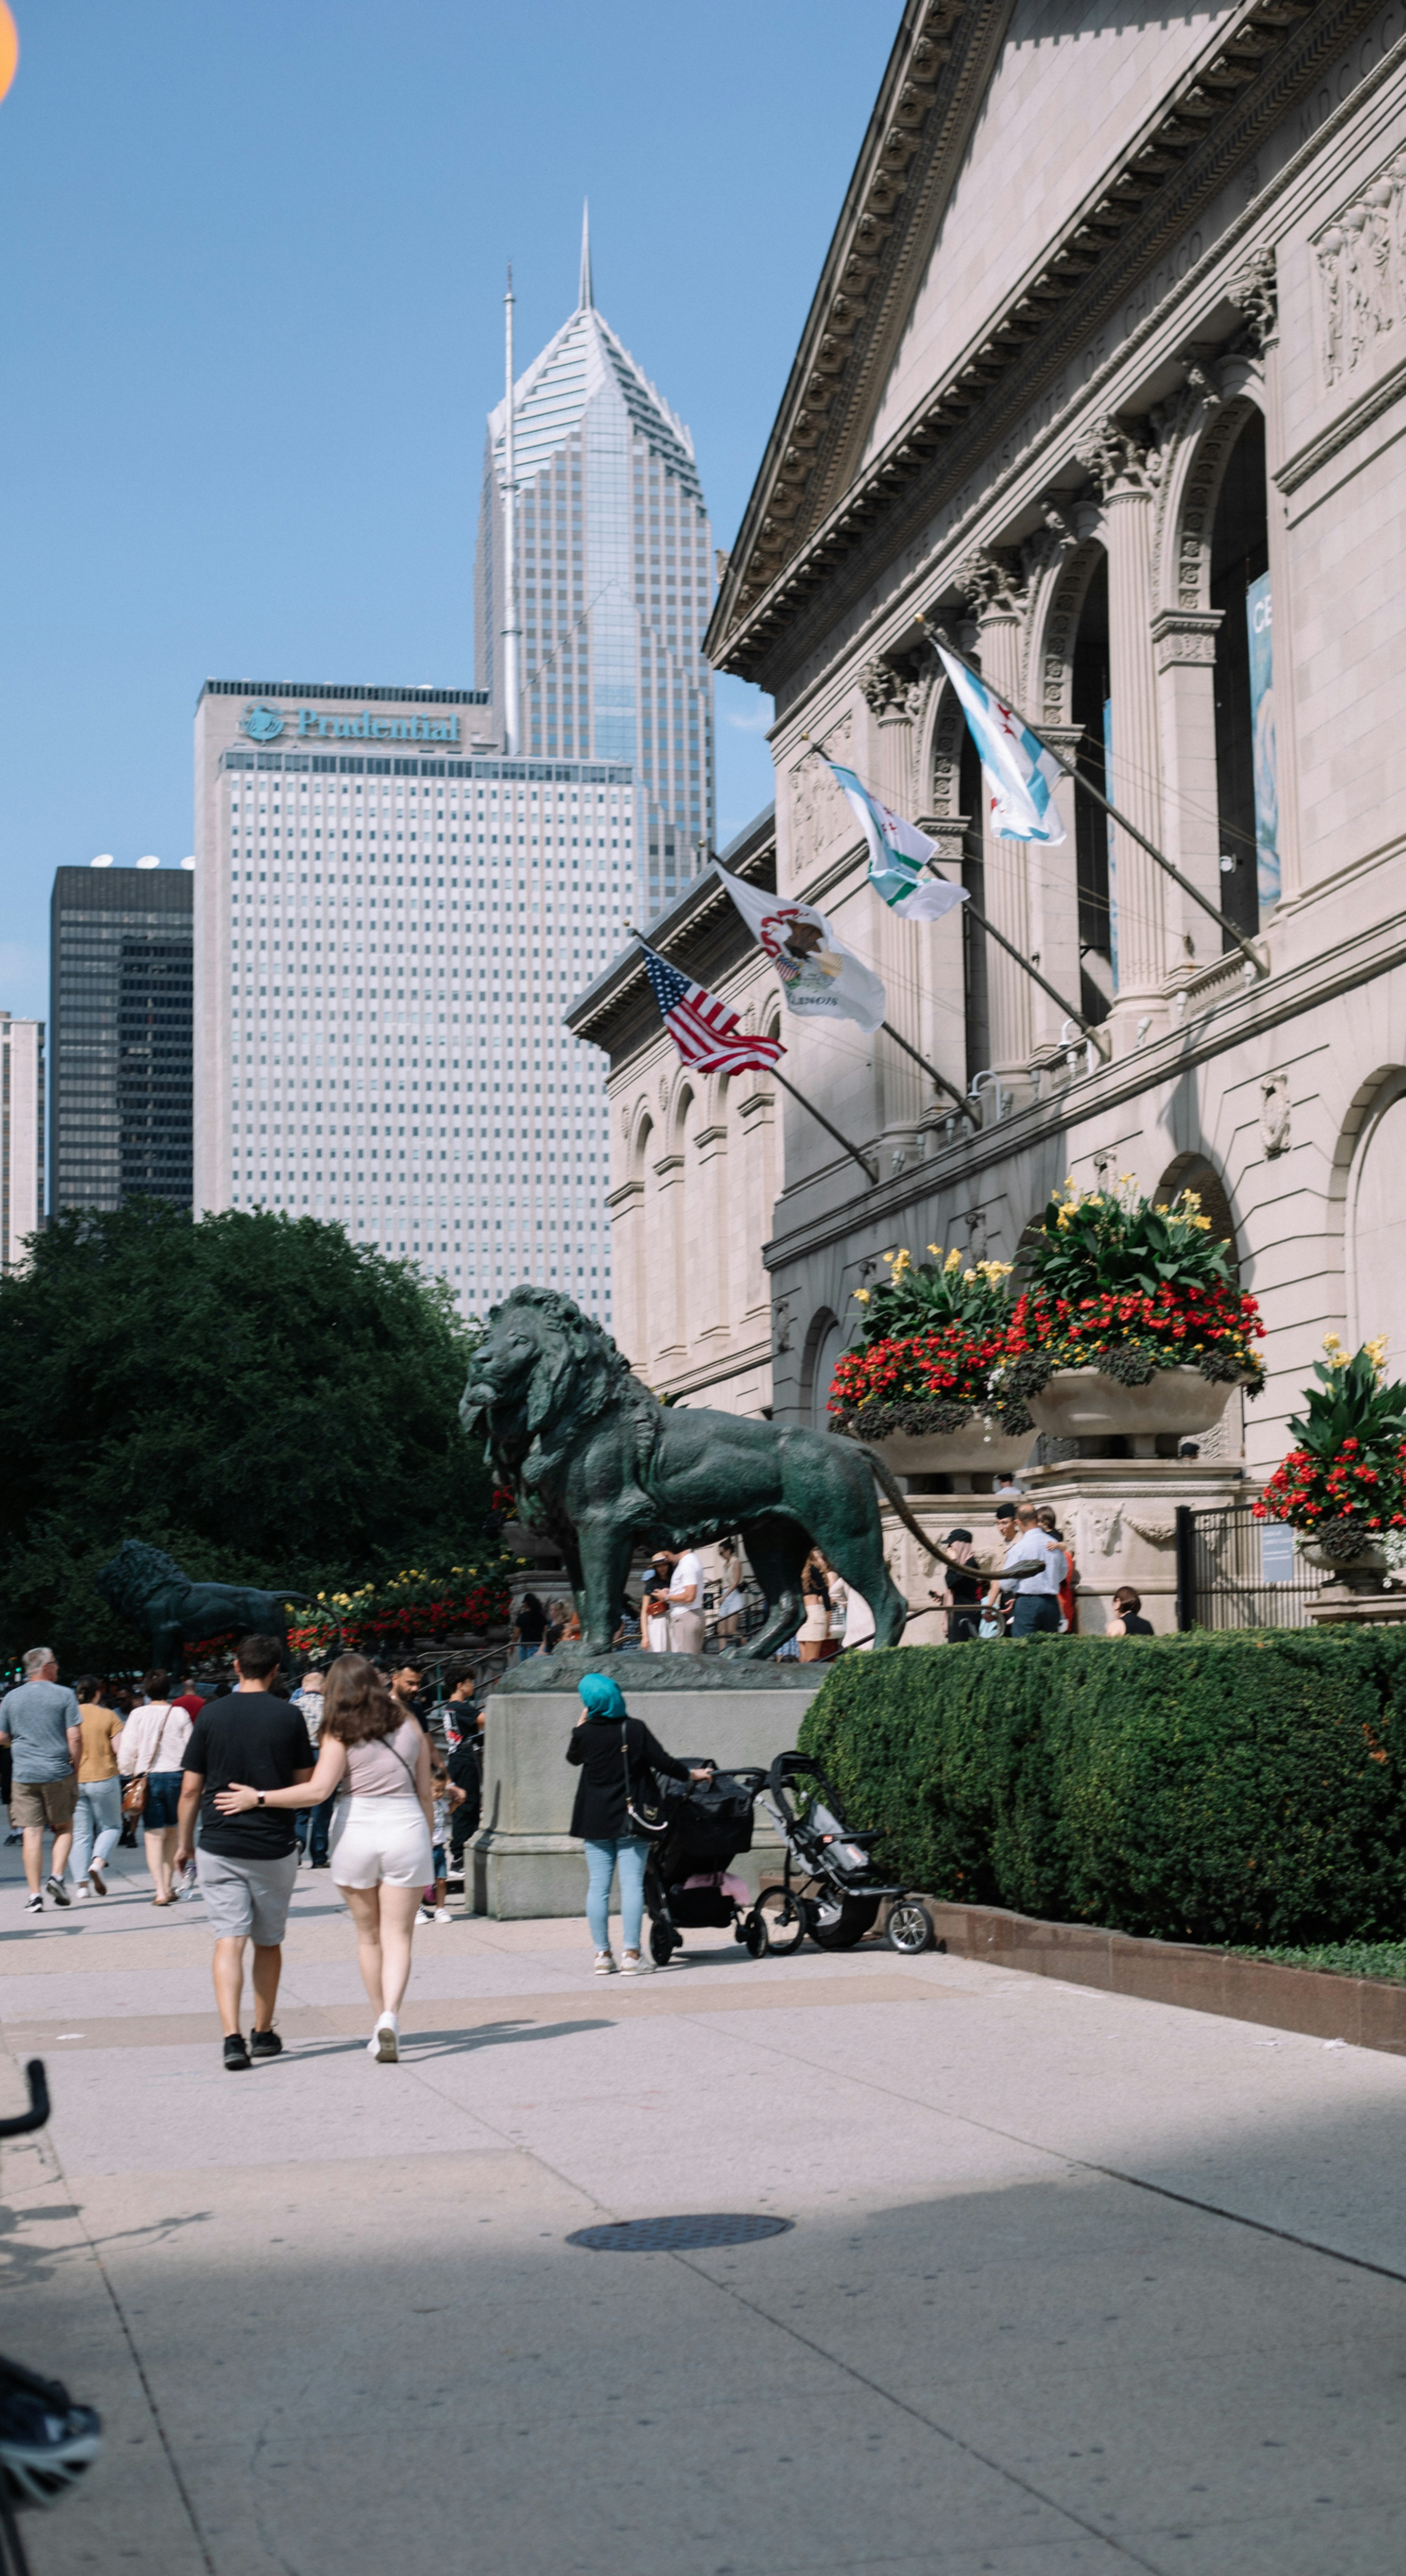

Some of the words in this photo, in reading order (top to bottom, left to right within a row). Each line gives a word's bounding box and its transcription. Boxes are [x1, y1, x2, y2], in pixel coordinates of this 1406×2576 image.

[1083, 336, 1105, 382] OF
[1124, 231, 1203, 338] CHICAGO
[1299, 0, 1406, 143] MDCCC
[297, 707, 458, 740] Prudential
